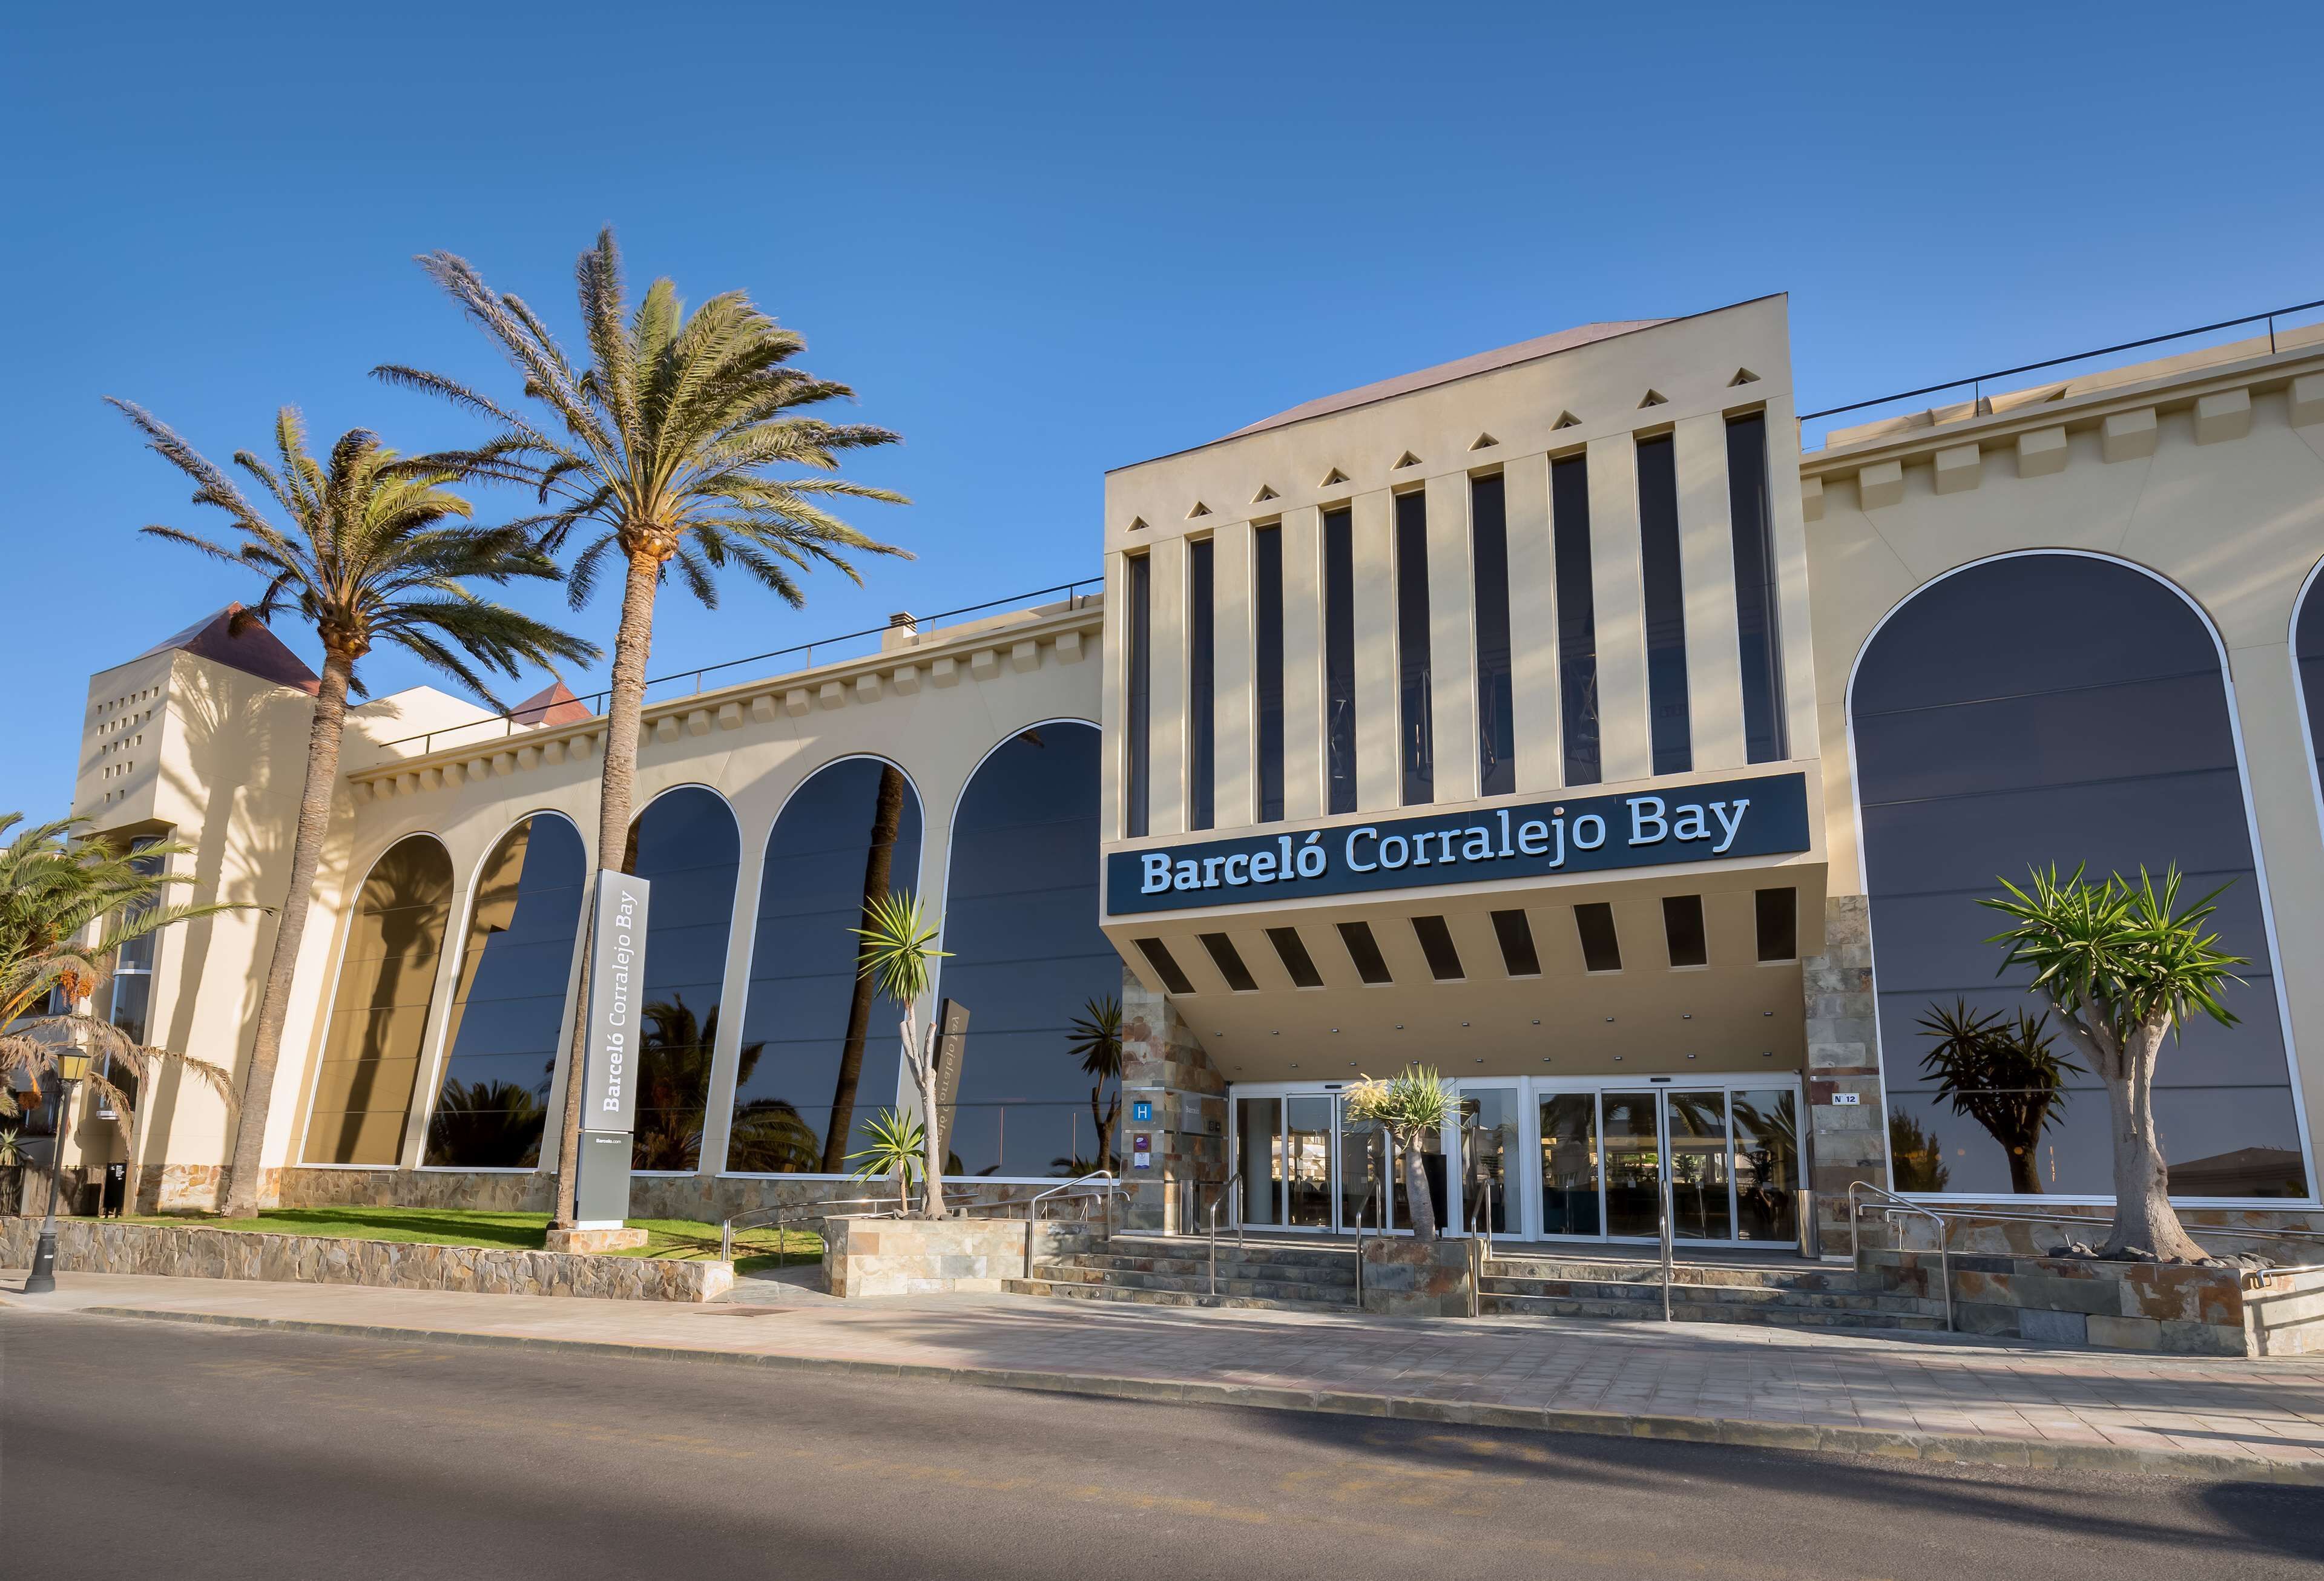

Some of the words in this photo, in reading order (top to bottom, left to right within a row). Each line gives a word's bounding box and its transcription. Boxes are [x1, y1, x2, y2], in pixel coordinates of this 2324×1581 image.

[1141, 830, 1327, 893] Barceló
[1346, 807, 1606, 872] Corralejo
[1626, 797, 1750, 853] Bay
[615, 890, 638, 930] Bay
[609, 935, 634, 1027] Corralejo
[603, 1033, 624, 1113] Barceló
[1137, 1106, 1147, 1119] H
